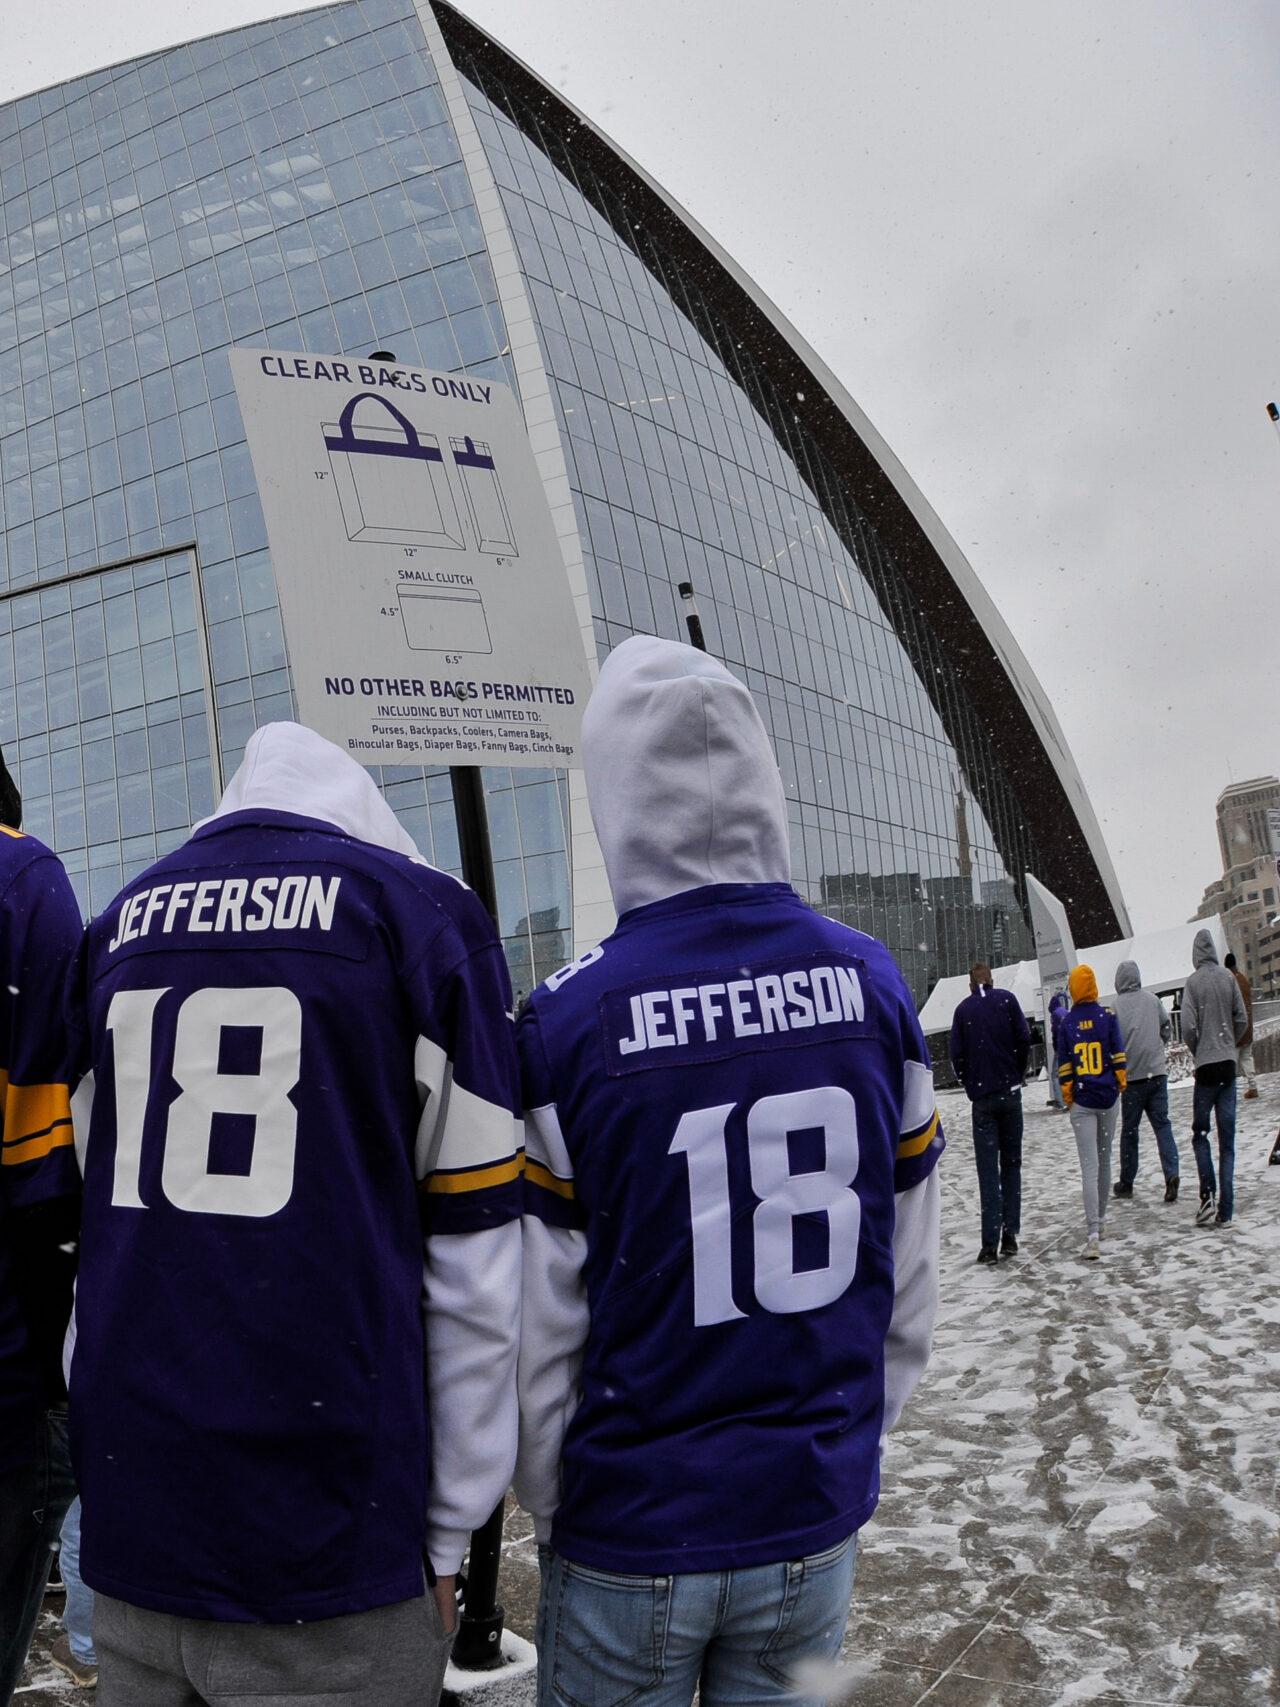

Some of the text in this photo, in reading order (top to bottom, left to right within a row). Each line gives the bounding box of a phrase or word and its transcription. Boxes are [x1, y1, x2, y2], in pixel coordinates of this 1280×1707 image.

[260, 356, 492, 404] CLEAR BAGS ONLY
[398, 570, 474, 585] SMALL CLUTCH
[325, 677, 355, 696] NO
[360, 678, 426, 697] OTHER
[482, 683, 575, 705] PERMITTED
[377, 705, 542, 722] INCLUDING BUT NOT LIMITED TO:
[348, 739, 574, 755] Binocular Bags, Diaper Bags, Fanny Bags, Cinch Bags
[372, 725, 552, 741] Purses, Backpacks, Coolers, Camera Bags,
[109, 876, 341, 953] JEFFERSON
[619, 966, 865, 1055] JEFFERSON
[1074, 1042, 1102, 1076] 30
[106, 986, 302, 1218] 18
[667, 1086, 862, 1327] 18
